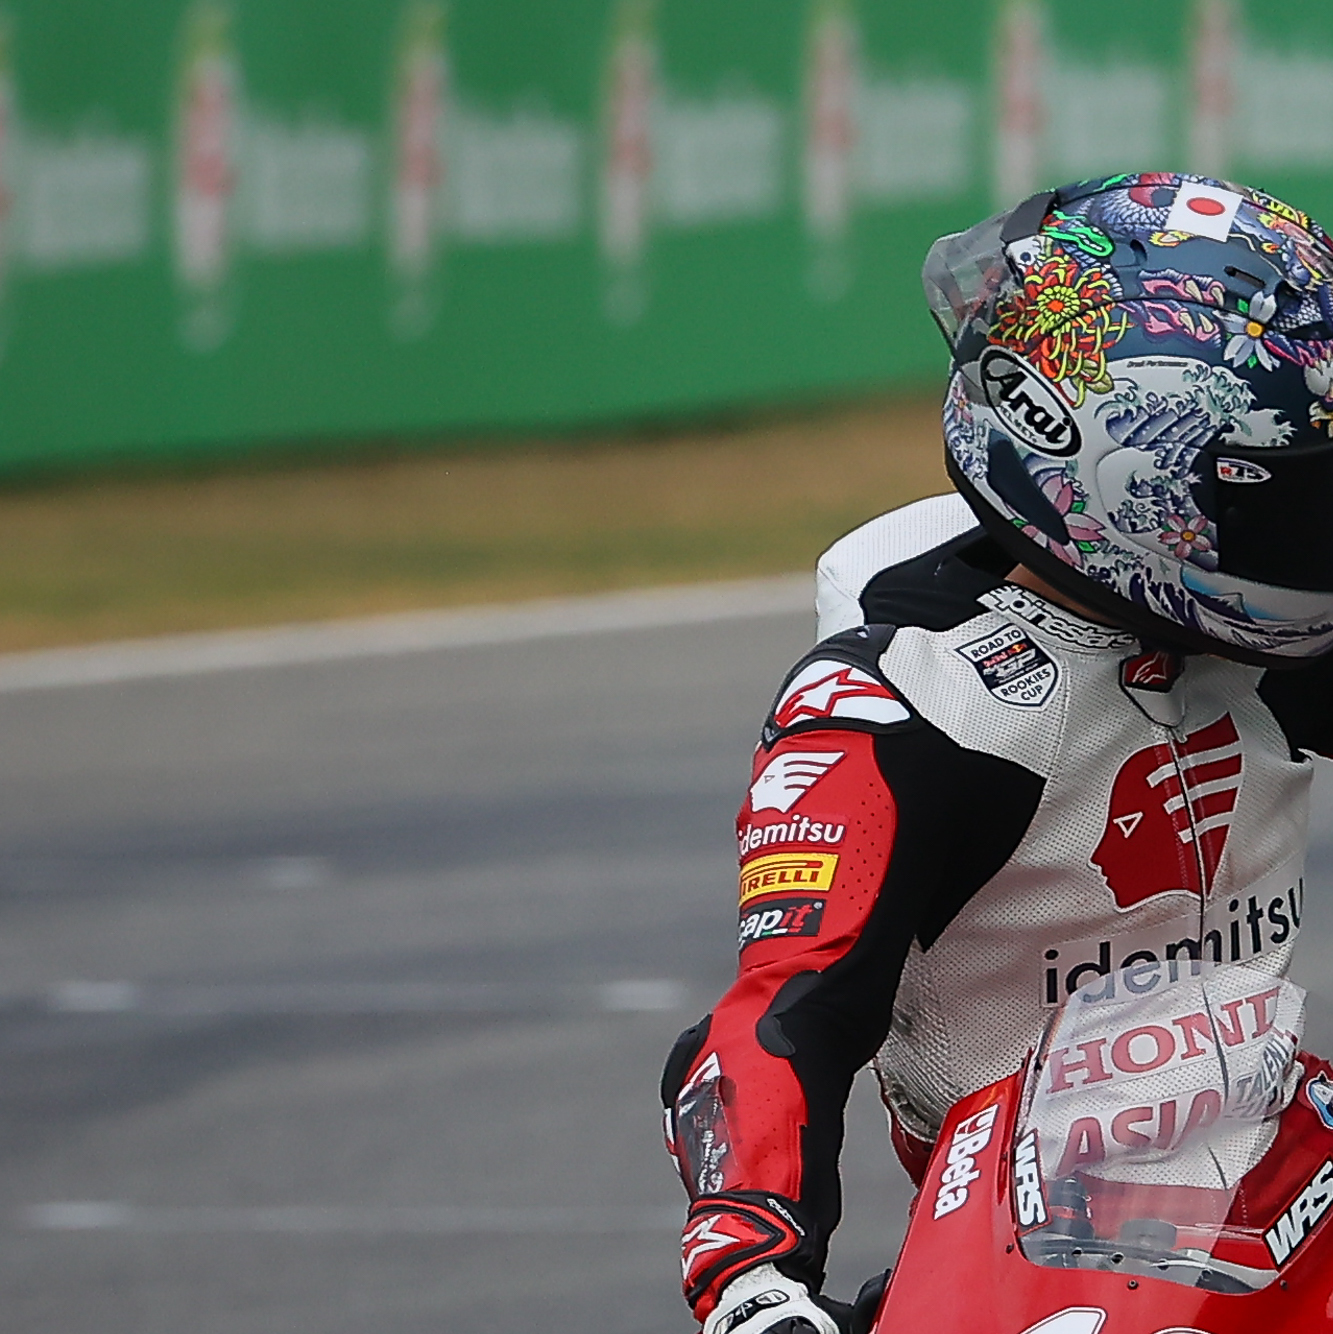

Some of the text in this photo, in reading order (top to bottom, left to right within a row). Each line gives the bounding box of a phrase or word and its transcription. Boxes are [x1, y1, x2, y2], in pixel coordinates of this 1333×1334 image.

[984, 369, 1073, 445] Arai
[970, 636, 1004, 659] ROAD
[1005, 628, 1022, 642] TO
[1000, 668, 1051, 698] ROOKIES
[1020, 684, 1044, 702] CUP
[1043, 878, 1304, 1003] idemitsu
[934, 1128, 991, 1221] Beta
[1015, 1132, 1047, 1226] WRS
